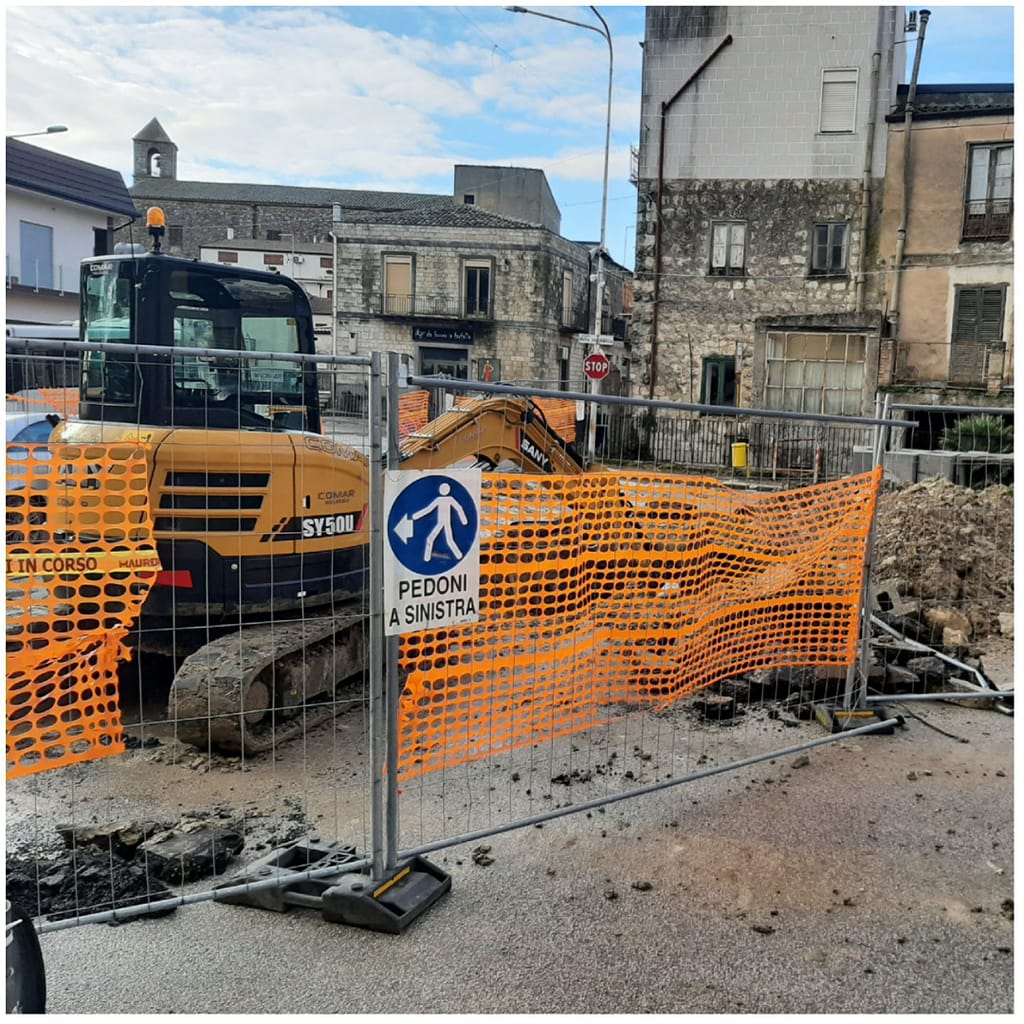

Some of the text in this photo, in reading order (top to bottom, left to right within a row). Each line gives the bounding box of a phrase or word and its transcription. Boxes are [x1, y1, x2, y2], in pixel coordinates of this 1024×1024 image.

[585, 361, 608, 372] STOP
[521, 439, 549, 467] SANY
[317, 489, 356, 500] COMAR
[303, 514, 354, 537] SY50U
[19, 558, 37, 573] IN
[42, 557, 98, 573] CORSO
[118, 558, 160, 568] MAURER
[399, 574, 467, 600] PEDONI
[389, 597, 476, 627] A SINISTRA
